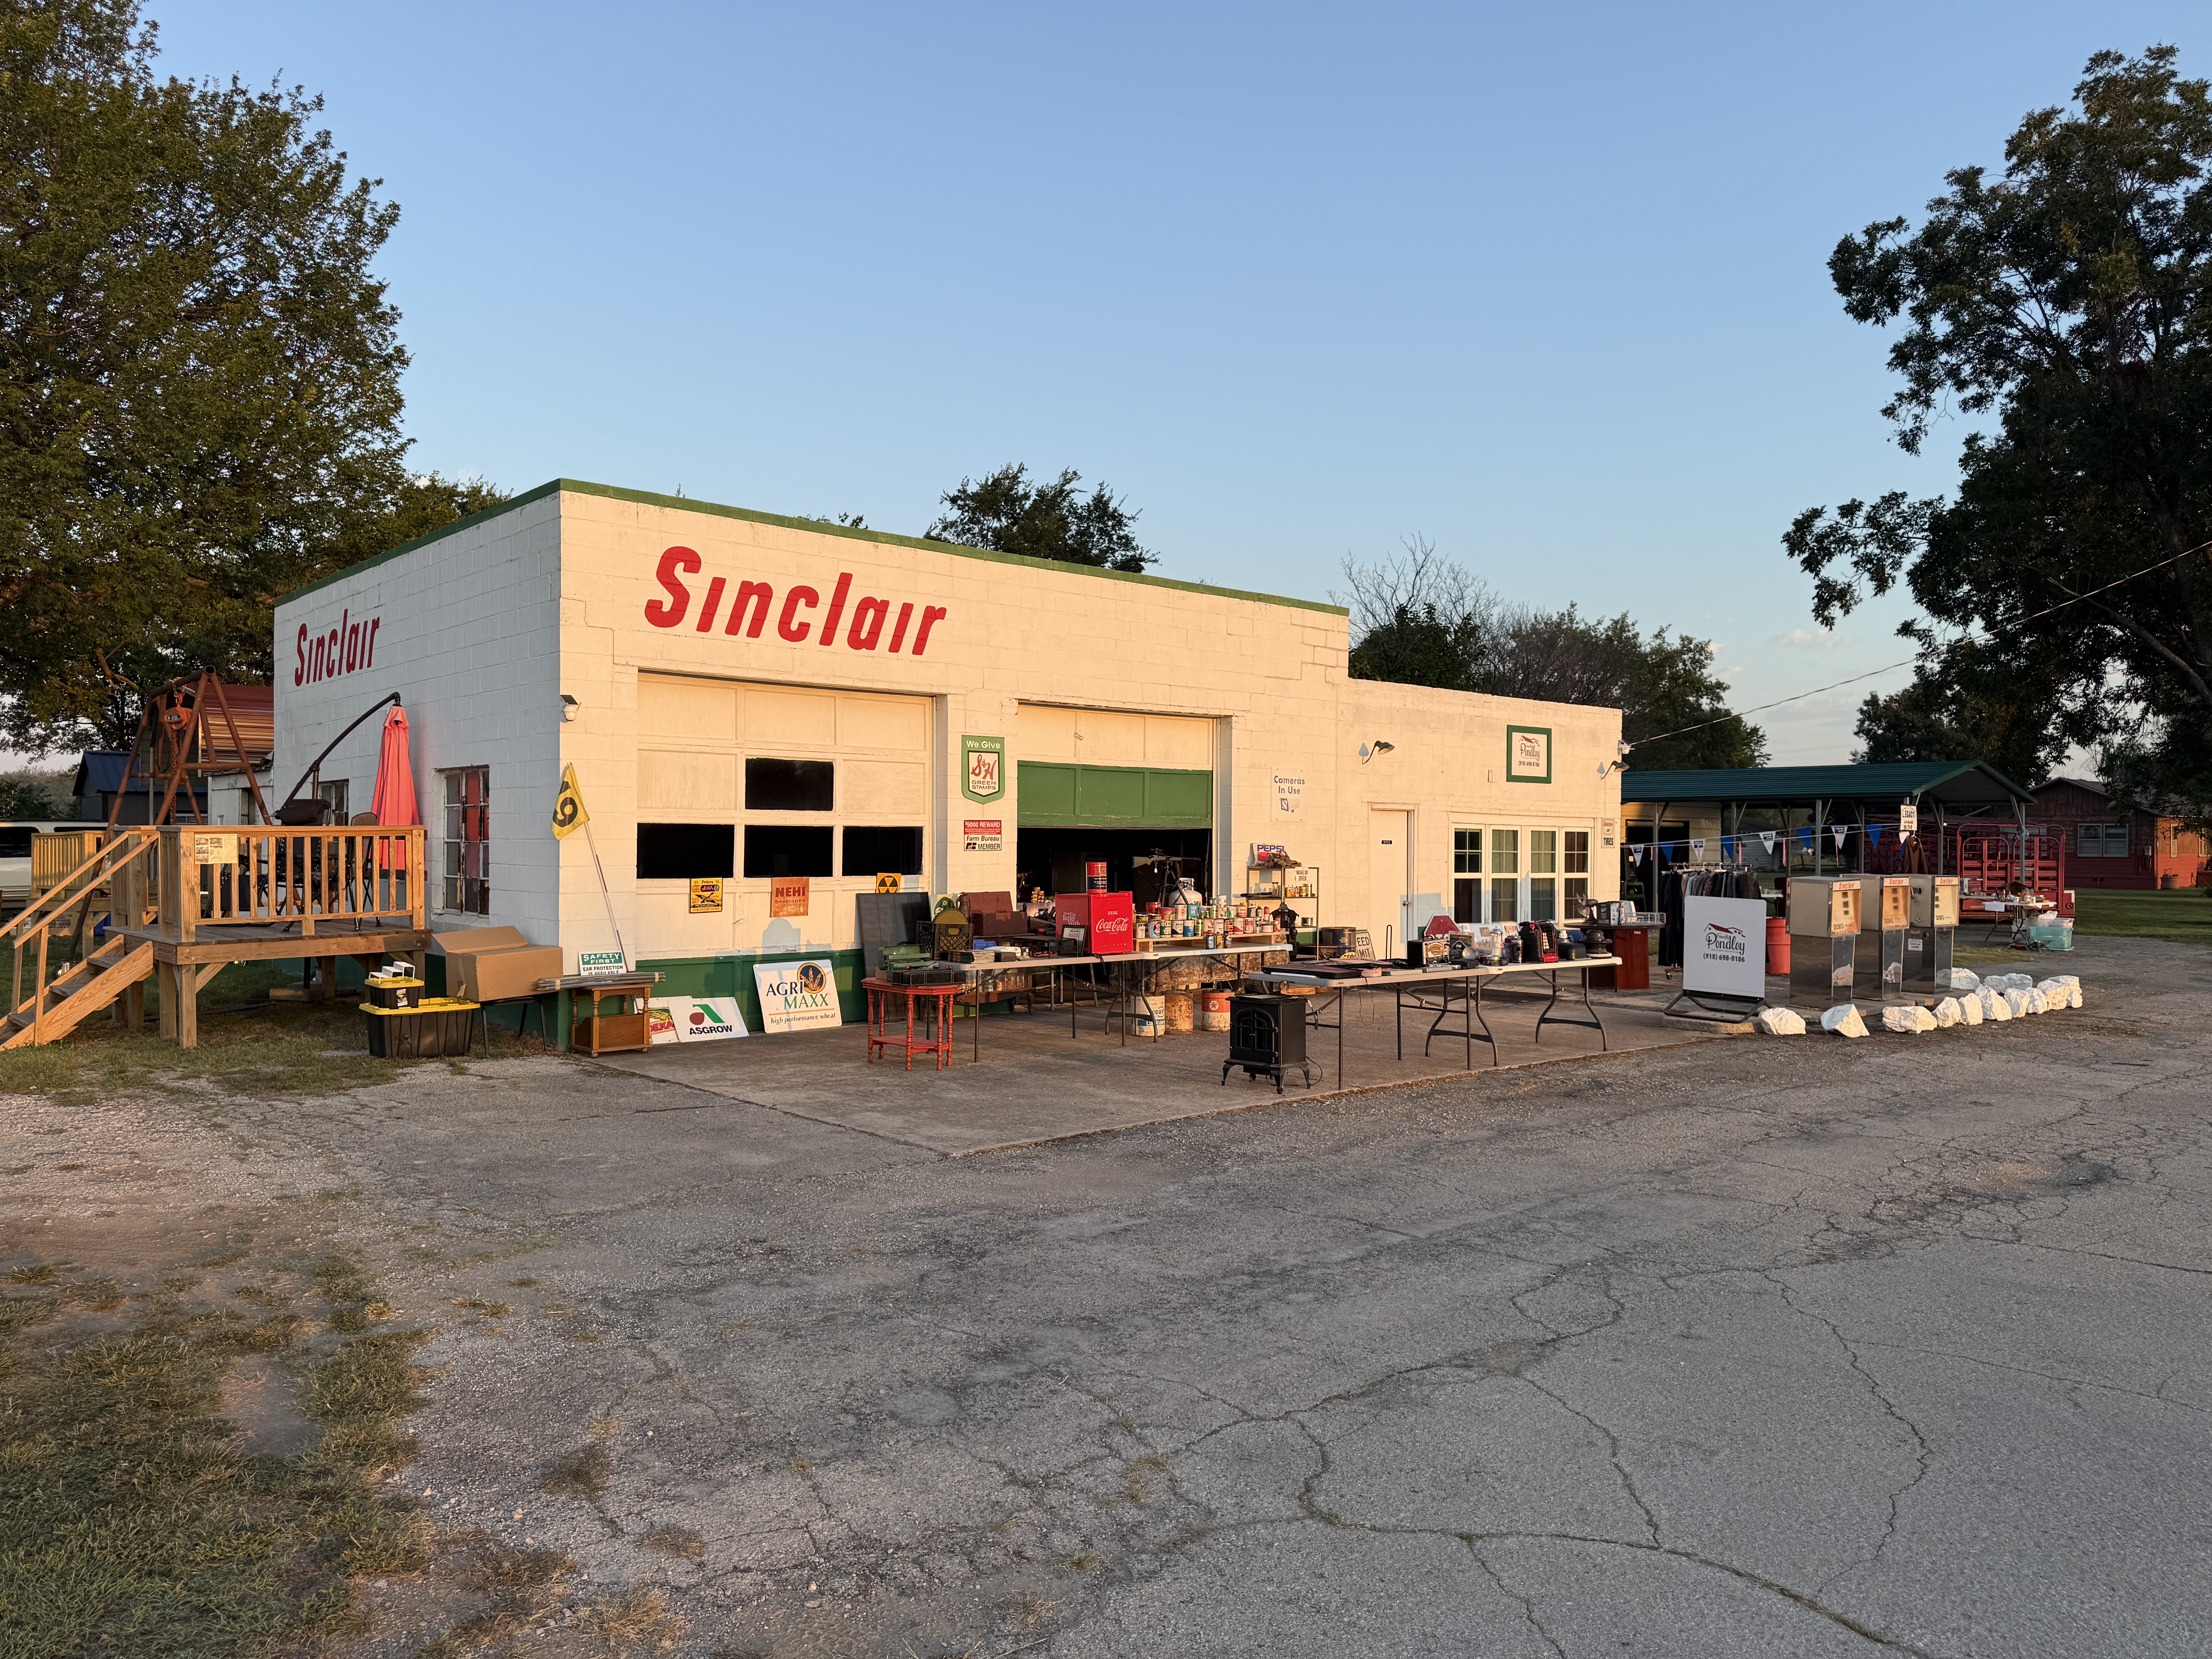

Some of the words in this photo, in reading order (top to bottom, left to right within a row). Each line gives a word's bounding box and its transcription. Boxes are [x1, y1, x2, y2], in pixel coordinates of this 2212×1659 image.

[644, 545, 947, 656] Sinclair
[294, 608, 381, 687] Sinclair
[971, 754, 997, 780] S&H
[1274, 775, 1305, 785] Cameras
[1279, 786, 1285, 794] In
[1288, 786, 1301, 794] Use
[1257, 844, 1285, 853] PEPSI
[775, 886, 806, 898] NEHI
[1096, 917, 1130, 933] Coca-Cola
[1357, 937, 1370, 946] EED
[1705, 932, 1745, 956] Pendley
[583, 953, 620, 962] SAFETY
[1357, 948, 1370, 958] IMIT
[766, 980, 805, 996] AGRI
[784, 993, 829, 1010] MAXX
[785, 1014, 819, 1024] performance
[689, 1025, 733, 1035] ASGROW
